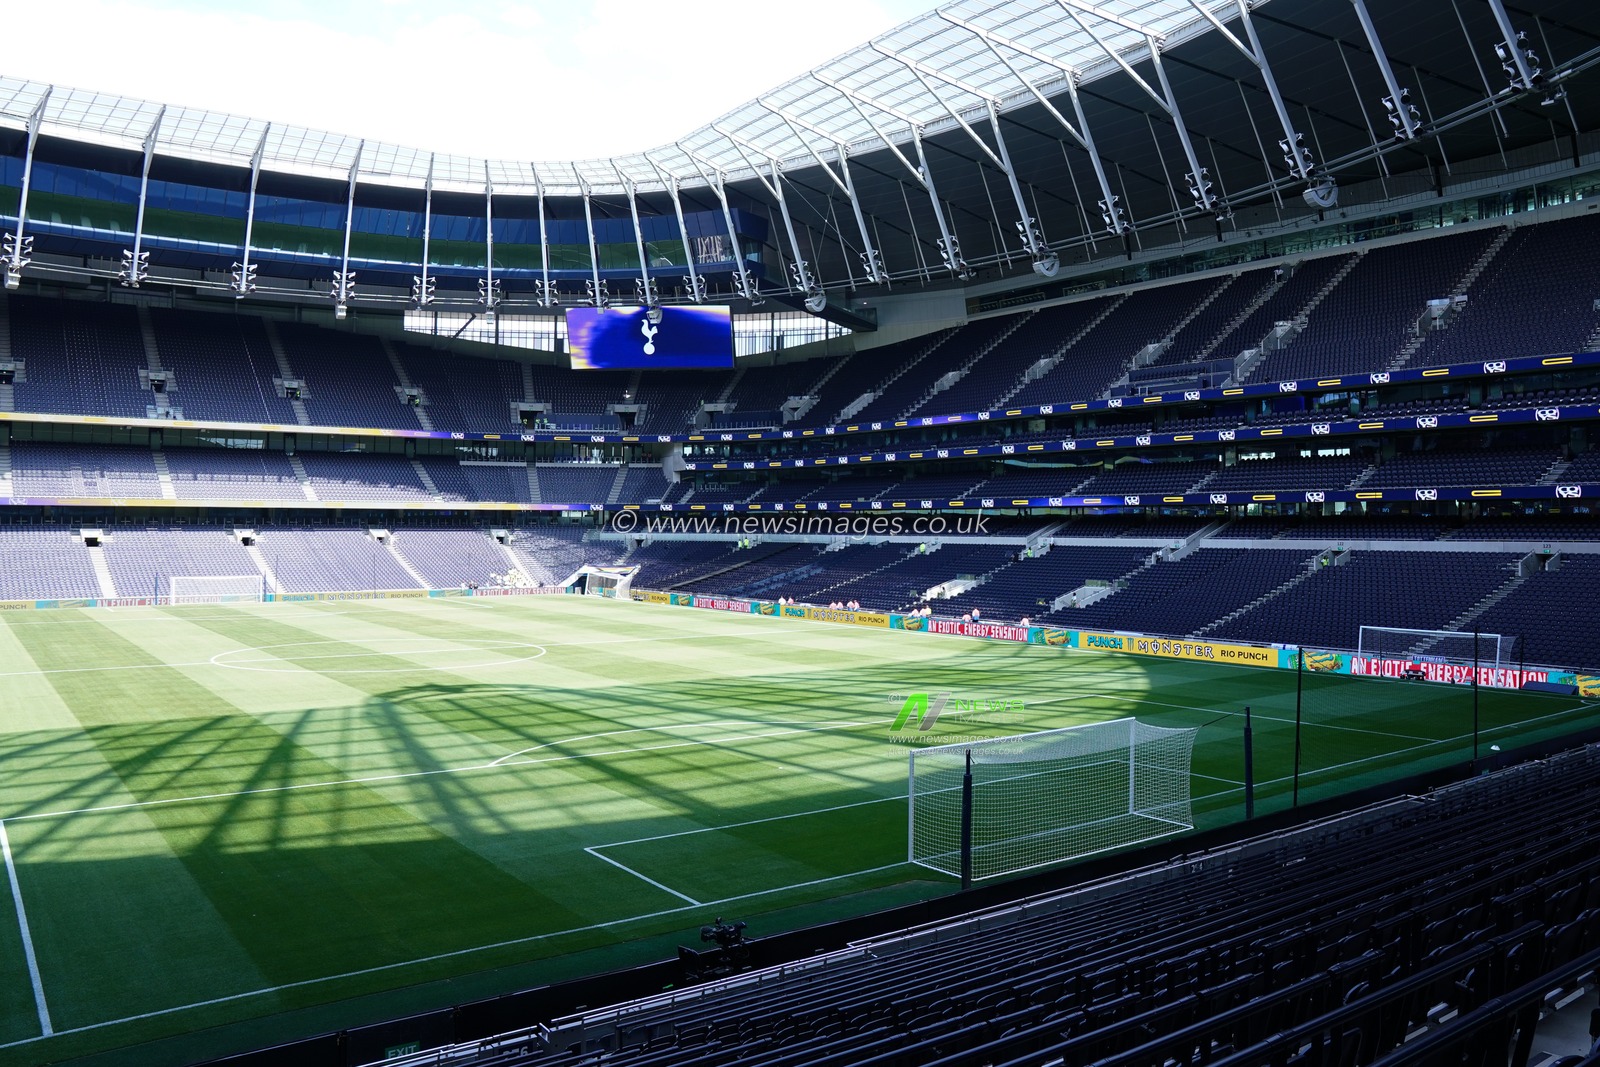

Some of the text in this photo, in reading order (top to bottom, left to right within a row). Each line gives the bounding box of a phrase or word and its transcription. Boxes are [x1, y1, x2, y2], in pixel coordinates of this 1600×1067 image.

[693, 597, 700, 607] AN
[713, 599, 728, 611] ENERGY
[729, 600, 751, 613] SENSATION
[784, 607, 806, 618] PUNCH
[867, 616, 885, 624] PUNCH
[928, 619, 937, 632] AN
[964, 622, 988, 638] ENERGY
[990, 625, 1028, 642] SENSATION
[1087, 635, 1268, 661] PUNCH MONSTER RIO PUNCH
[1351, 656, 1367, 676] AN
[1420, 663, 1469, 684] ENERGY
[387, 1044, 417, 1060] EXIT
